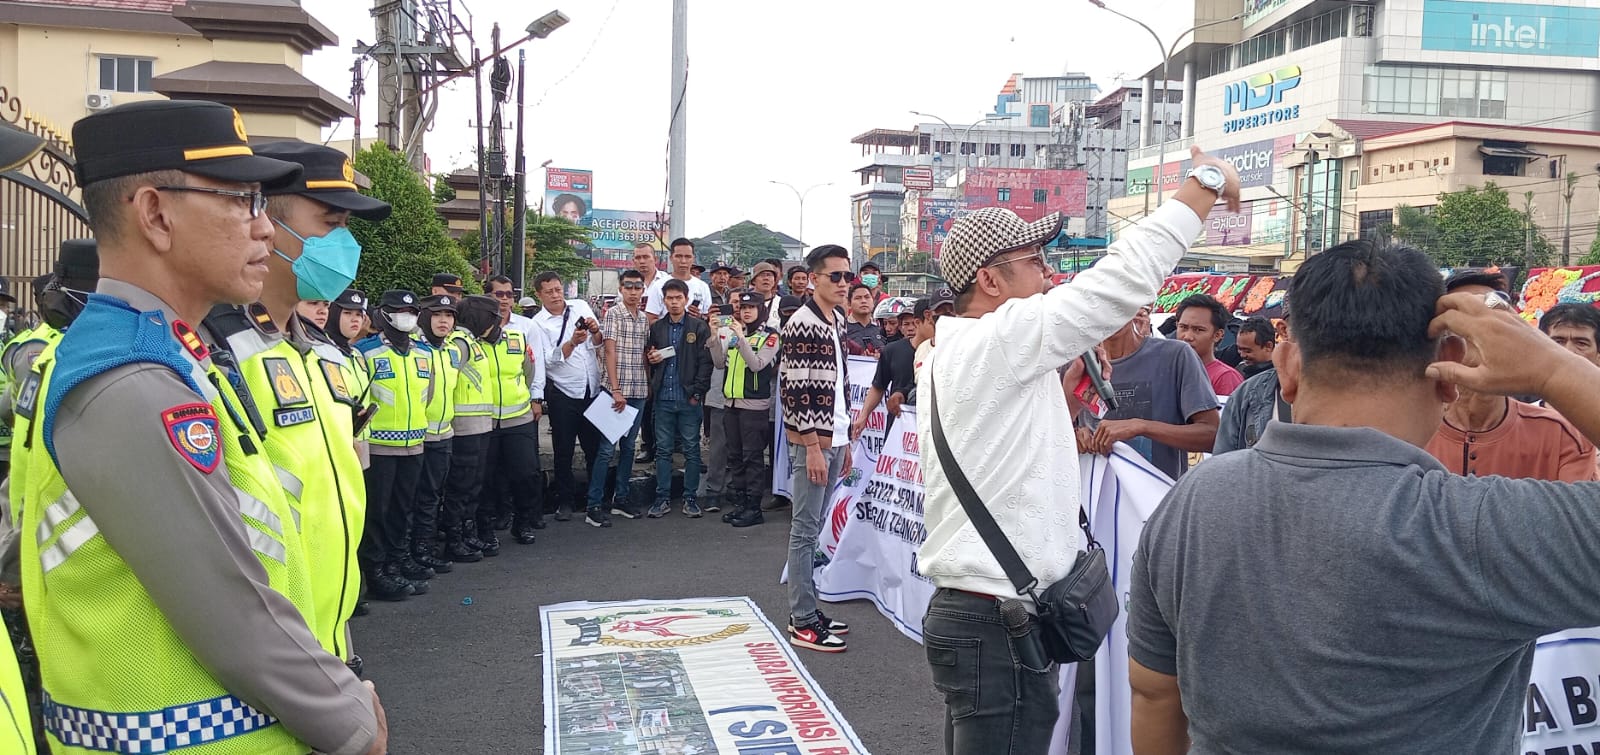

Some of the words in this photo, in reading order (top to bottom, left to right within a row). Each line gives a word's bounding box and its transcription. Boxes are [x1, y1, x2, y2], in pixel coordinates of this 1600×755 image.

[1471, 13, 1547, 50] intel
[1223, 104, 1300, 134] SUPERSTORE
[592, 231, 616, 240] 0711
[618, 232, 636, 241] 363
[638, 233, 656, 242] 393
[615, 220, 638, 230] FOR
[281, 411, 313, 425] POLRI
[744, 642, 792, 676] SUARA
[767, 676, 841, 743] INFORMASI
[1521, 683, 1558, 733] A
[1561, 676, 1600, 726] B
